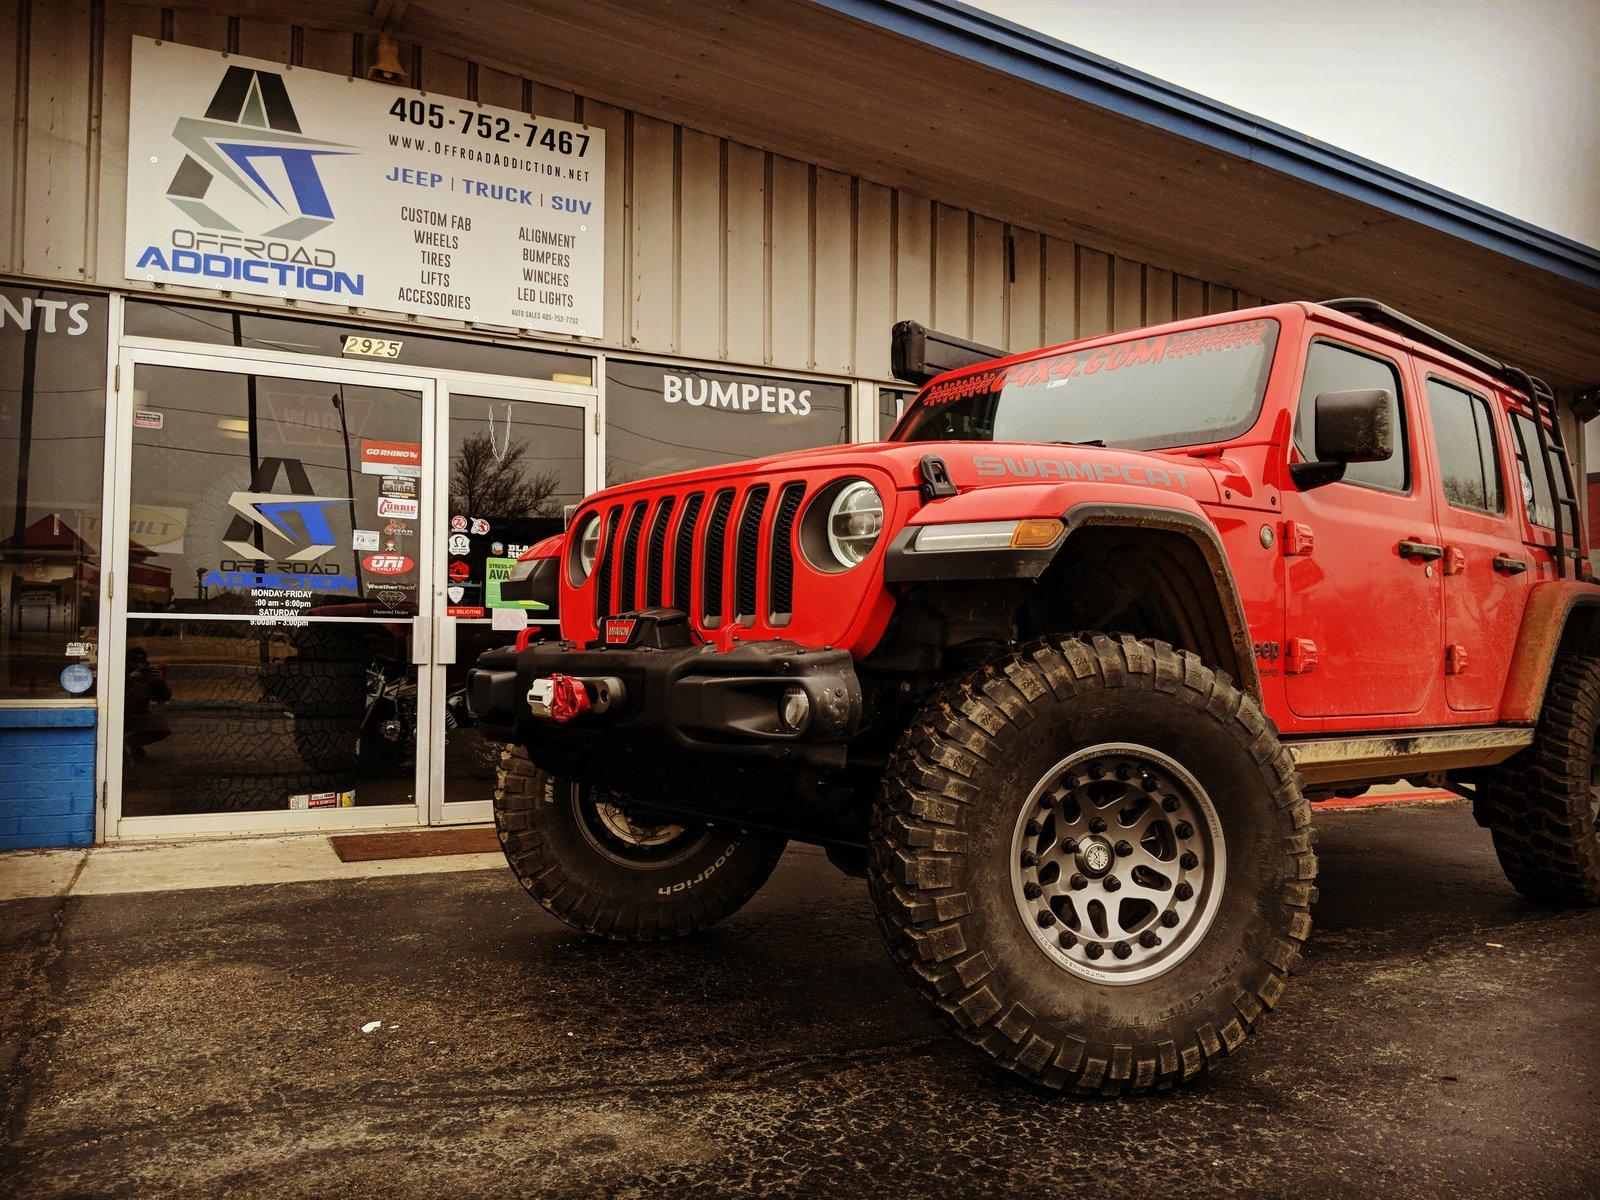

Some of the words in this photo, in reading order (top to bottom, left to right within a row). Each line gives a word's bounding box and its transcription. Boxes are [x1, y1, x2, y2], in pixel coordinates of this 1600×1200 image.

[388, 96, 591, 158] 405-752-7467
[385, 166, 443, 189] JEEP
[462, 178, 533, 206] TRUCK
[551, 195, 592, 216] SUV
[400, 206, 447, 228] CUSTOM
[451, 215, 472, 232] FAB
[171, 228, 336, 269] OFFROAD
[413, 229, 459, 250] WHEELS
[518, 226, 577, 250] ALIGNMENT
[420, 250, 452, 268] TIRES
[522, 247, 570, 268] BUMPERS
[135, 245, 365, 297] ADDICTION
[420, 270, 450, 288] LIFTS
[522, 267, 569, 288] WINCHES
[398, 286, 472, 310] ACCESSORIES
[517, 286, 536, 302] LED
[539, 289, 574, 308] LIGHTS
[511, 308, 525, 318] AUTO
[525, 310, 541, 320] SALES
[541, 312, 579, 325] 405-752-7732
[345, 337, 400, 358] 2925
[662, 374, 812, 416] BUMPERS
[971, 455, 1191, 490] SWAMPCAT
[488, 569, 510, 580] AVA
[250, 588, 313, 599] MONDAY-FRIDAY
[284, 599, 312, 609] 6:00pm
[258, 608, 300, 617] SATURDAY
[608, 626, 629, 636] WARN
[1253, 641, 1281, 660] eep
[657, 843, 738, 896] oodrich
[1059, 955, 1107, 980] HUTCHINSON
